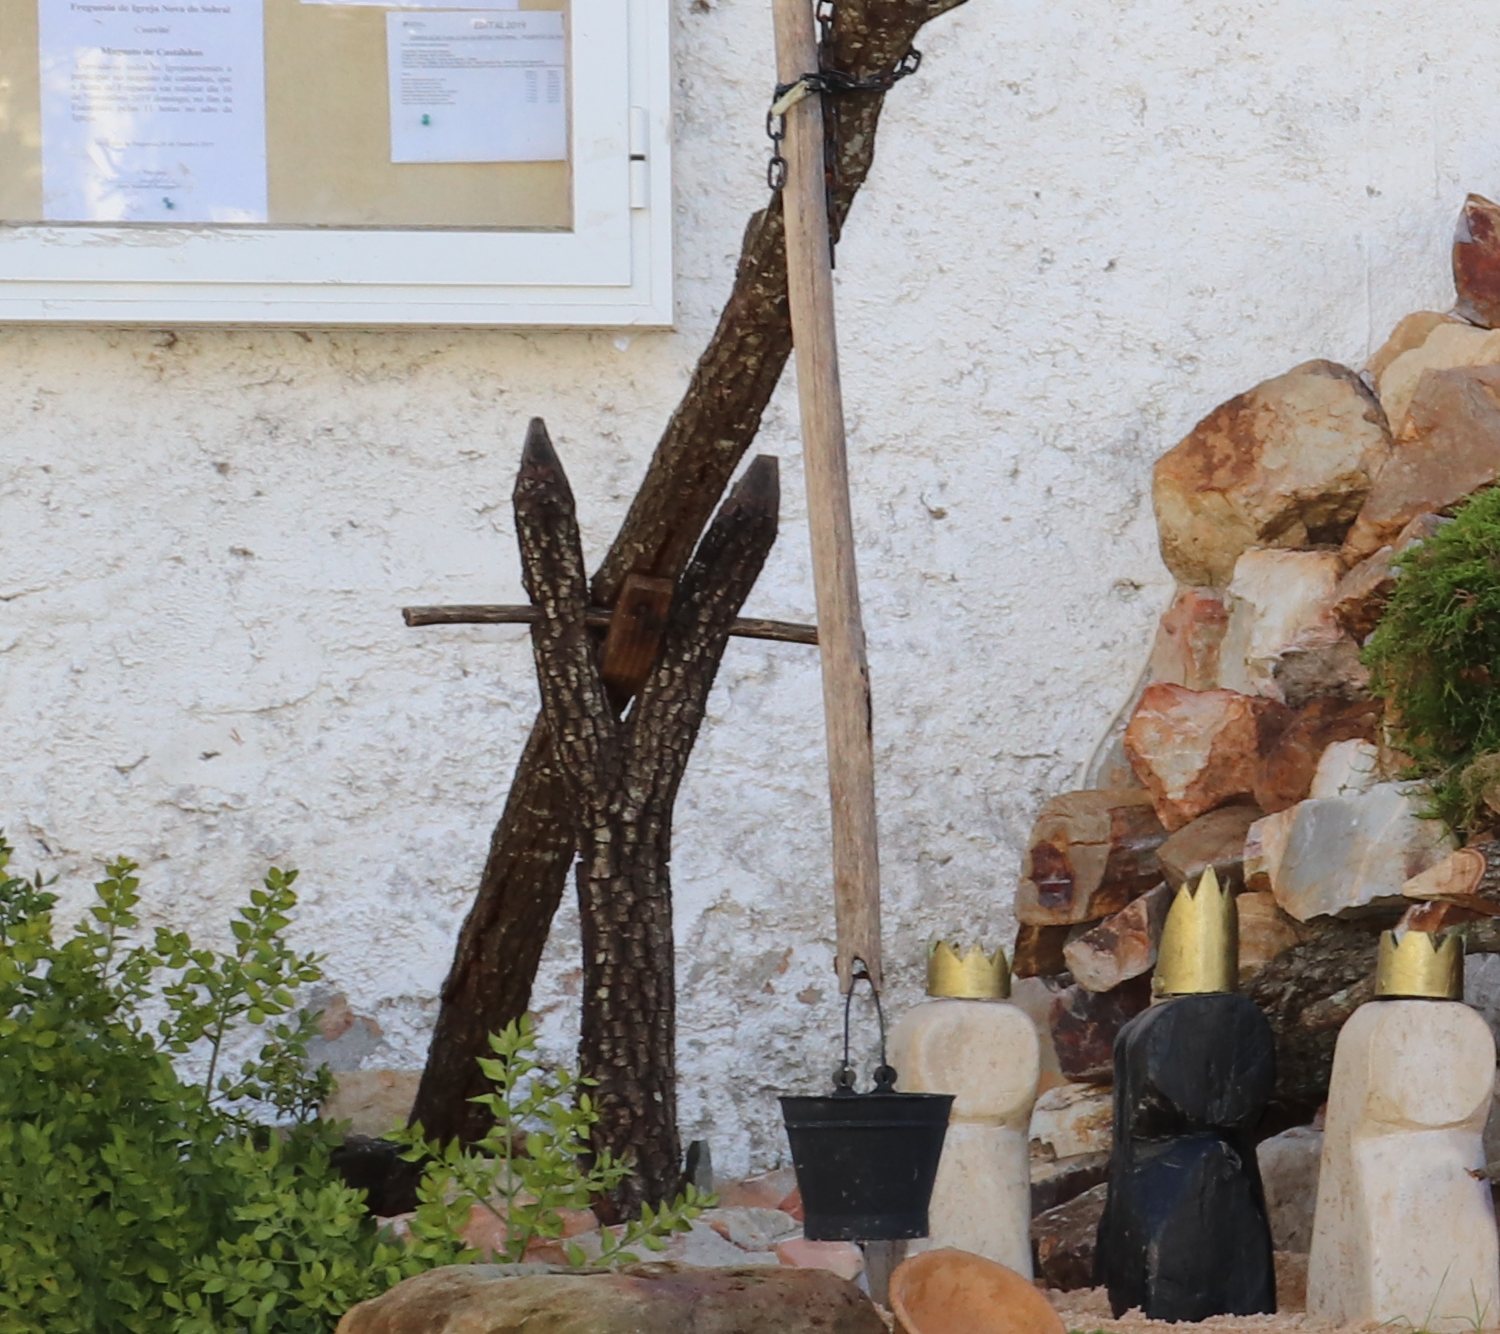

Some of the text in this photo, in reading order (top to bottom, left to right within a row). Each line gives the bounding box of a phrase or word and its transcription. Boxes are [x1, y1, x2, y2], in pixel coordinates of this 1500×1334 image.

[70, 2, 231, 14] Freguesia de Igreja Nova do Sobral
[473, 20, 527, 30] EDITAL 2019
[142, 48, 154, 56] de
